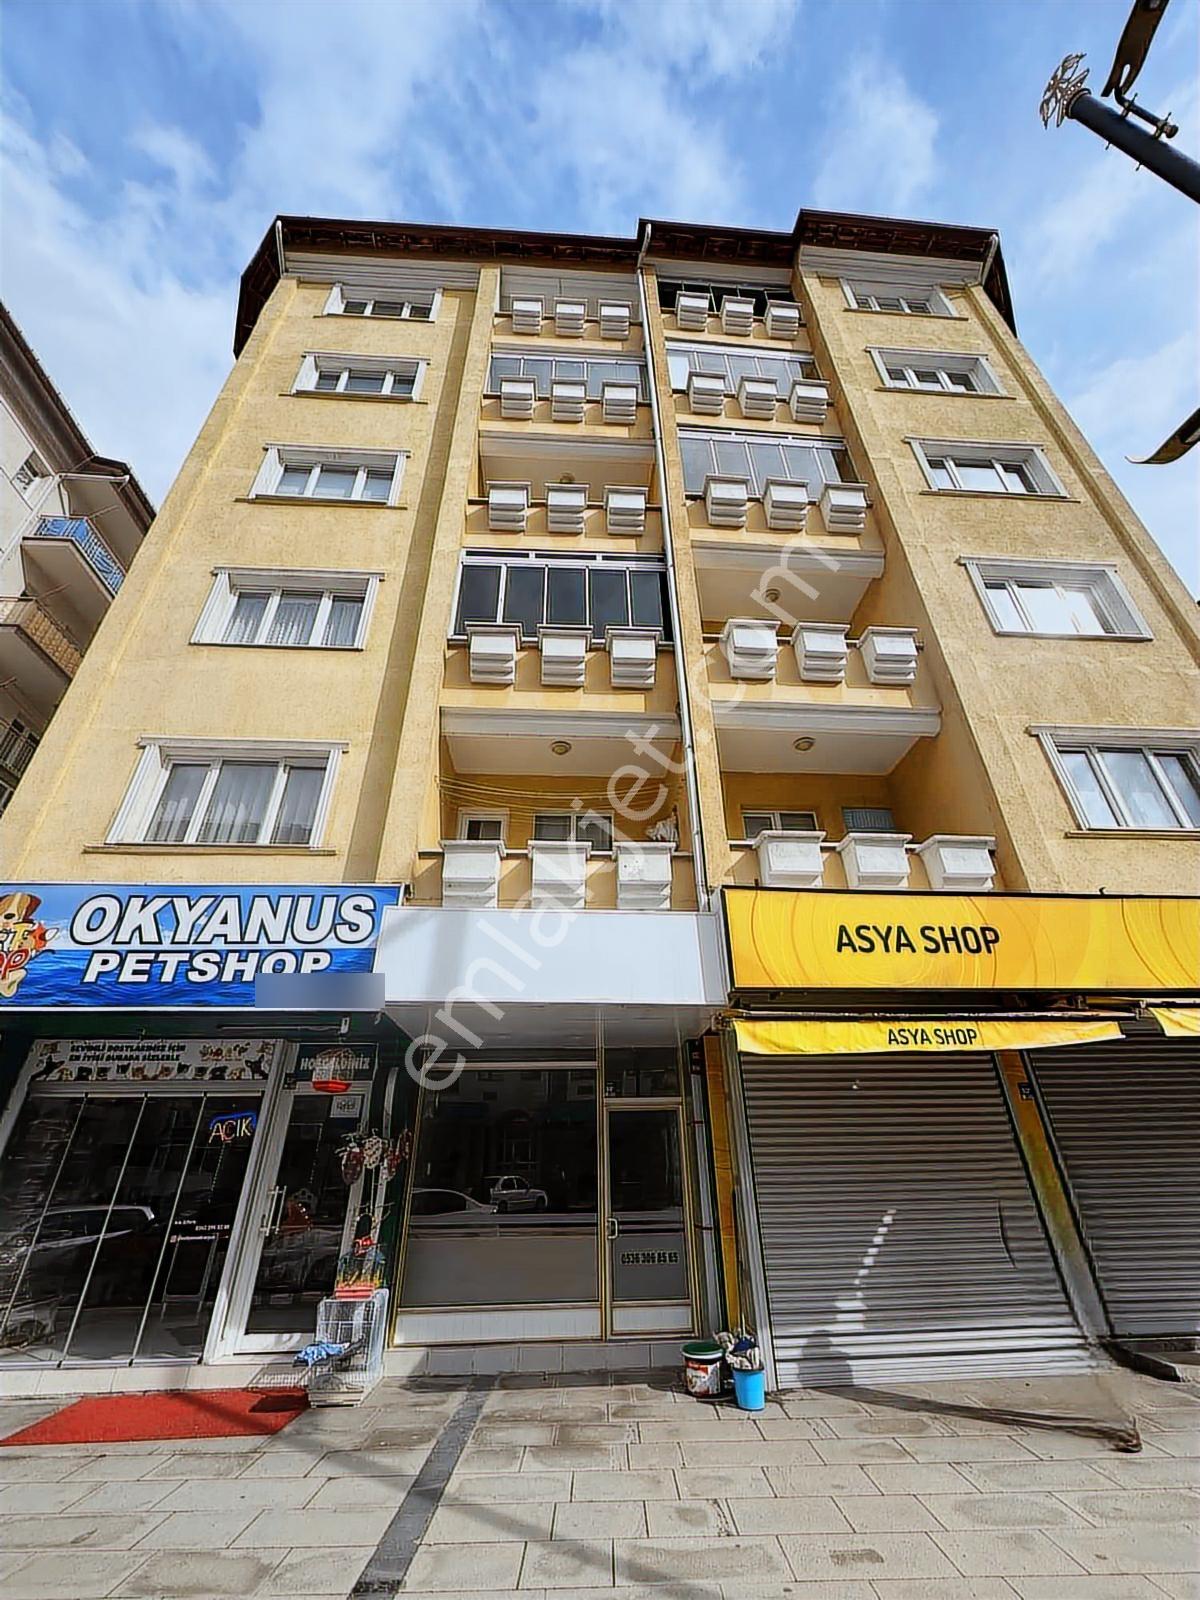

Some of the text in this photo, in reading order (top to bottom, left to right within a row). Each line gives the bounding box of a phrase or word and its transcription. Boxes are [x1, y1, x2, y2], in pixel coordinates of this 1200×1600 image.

[71, 894, 375, 945] OKYANUS
[836, 924, 1000, 954] ASYA SHOP
[80, 949, 332, 984] PETSHOP
[888, 1028, 978, 1046] ASYA SHOP
